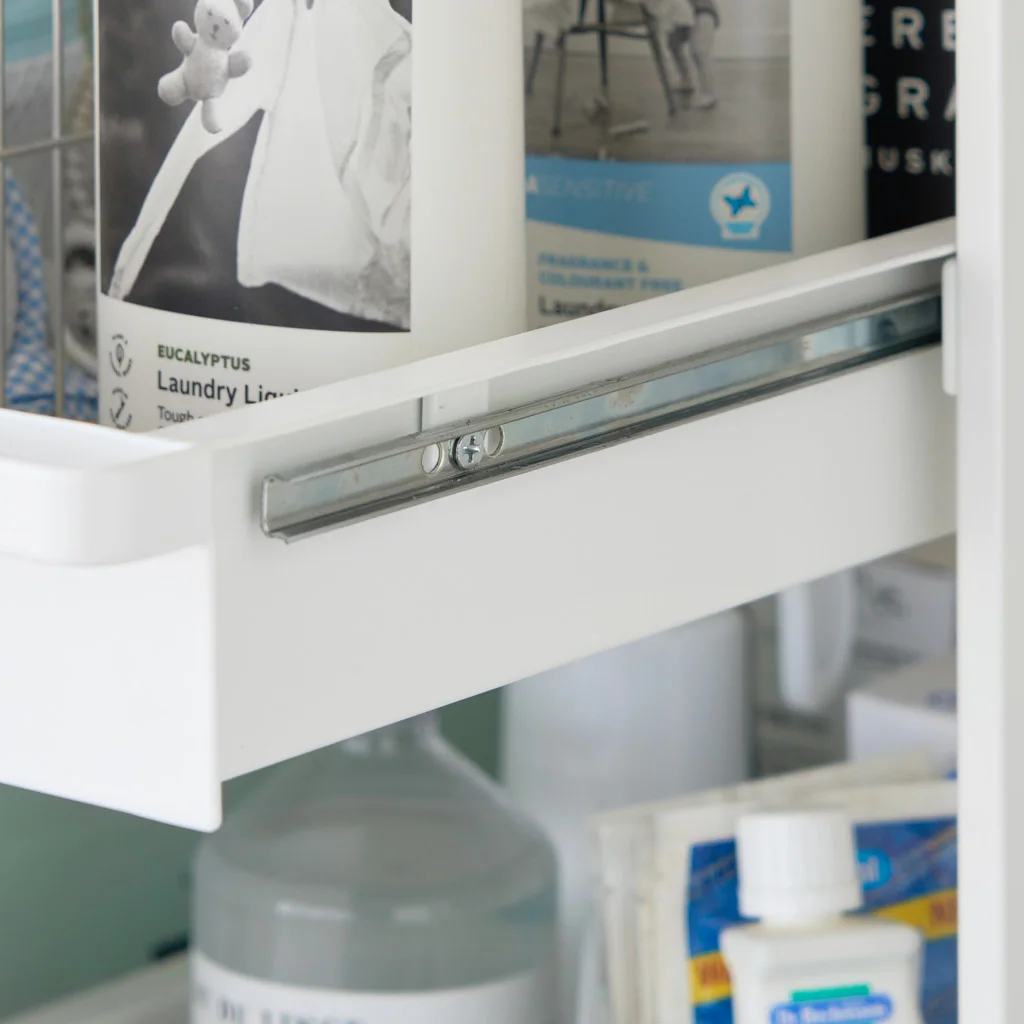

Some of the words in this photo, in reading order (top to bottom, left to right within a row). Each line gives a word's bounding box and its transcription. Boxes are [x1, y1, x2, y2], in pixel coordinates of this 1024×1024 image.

[863, 146, 954, 175] USK
[157, 344, 251, 372] EUCALYPTUS
[157, 370, 238, 407] Laundry
